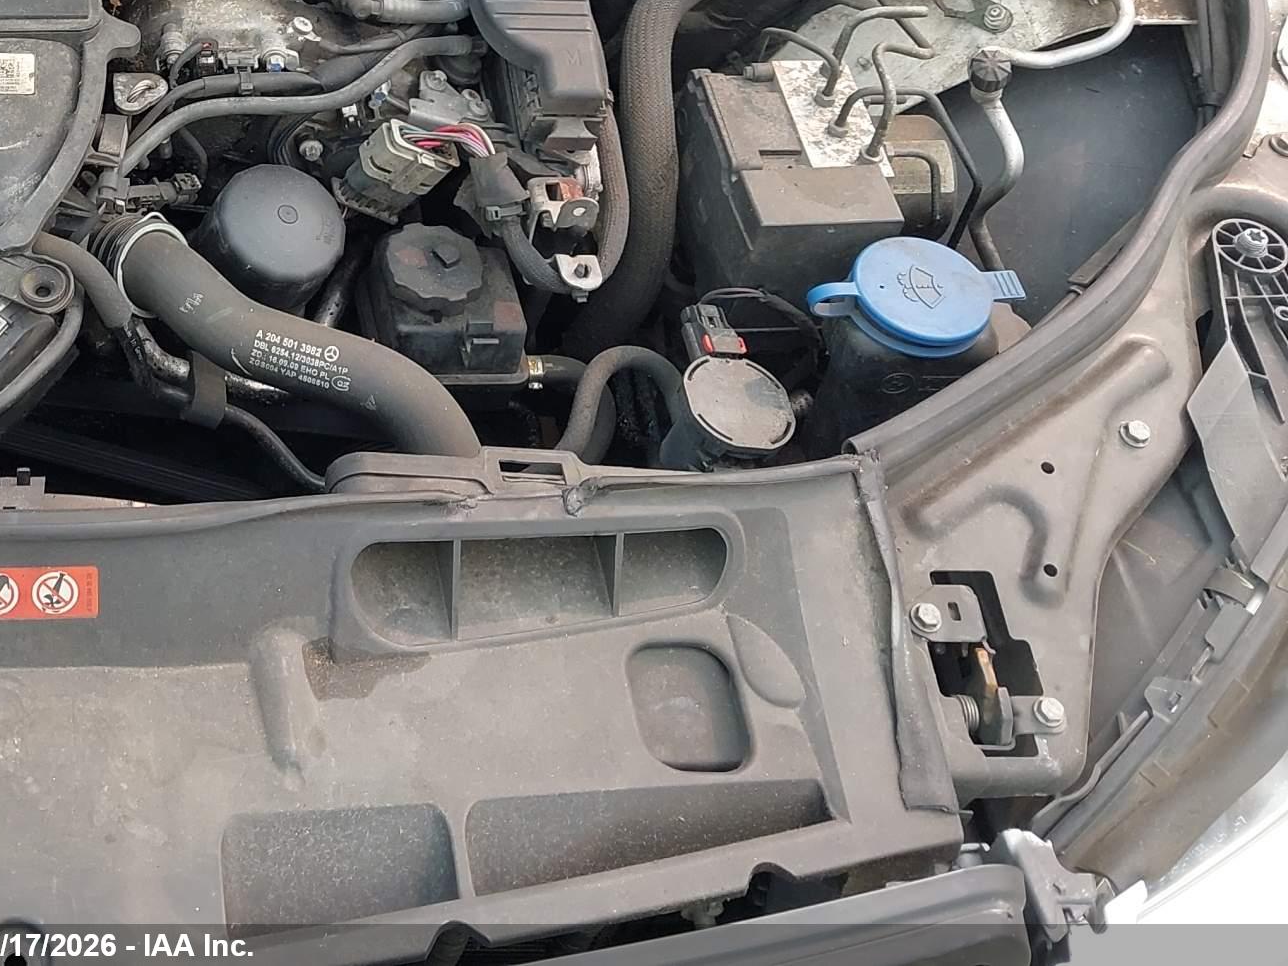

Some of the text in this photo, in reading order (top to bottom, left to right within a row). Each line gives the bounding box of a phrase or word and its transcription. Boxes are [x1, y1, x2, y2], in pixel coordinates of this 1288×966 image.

[255, 329, 263, 339] A
[265, 332, 281, 344] 204
[282, 337, 298, 350] 501
[280, 367, 297, 378] YAP
[319, 371, 330, 381] PL
